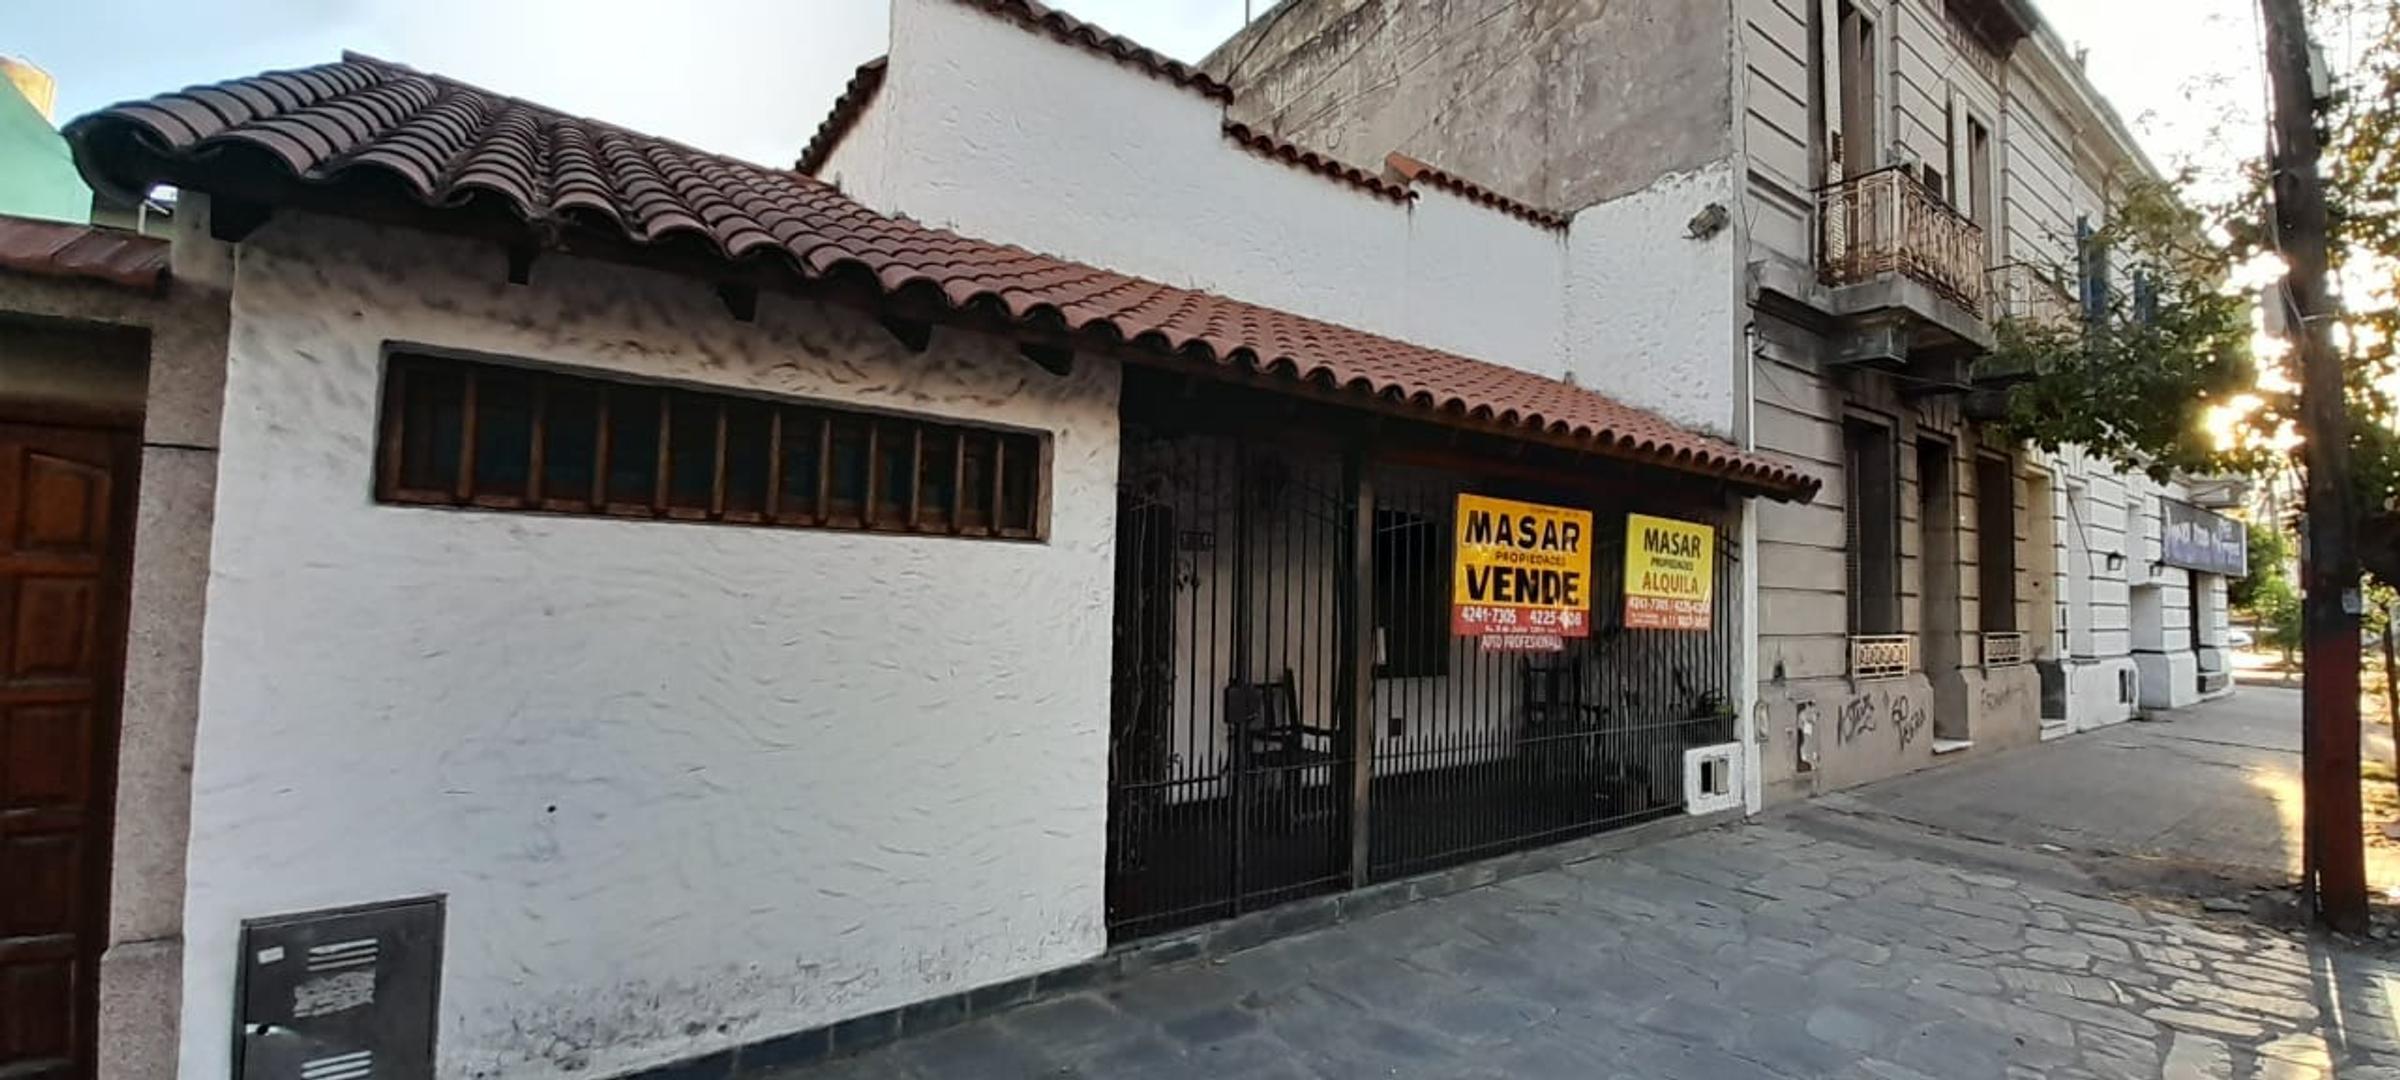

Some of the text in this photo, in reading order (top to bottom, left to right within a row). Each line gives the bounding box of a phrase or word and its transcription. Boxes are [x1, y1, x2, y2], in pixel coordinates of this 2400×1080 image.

[1465, 510, 1580, 553] MASAR
[1644, 527, 1701, 559] MASAR
[1495, 551, 1566, 567] PROPIEDADES
[1465, 563, 1580, 606] VENDE
[1642, 571, 1698, 594] ALQUILA
